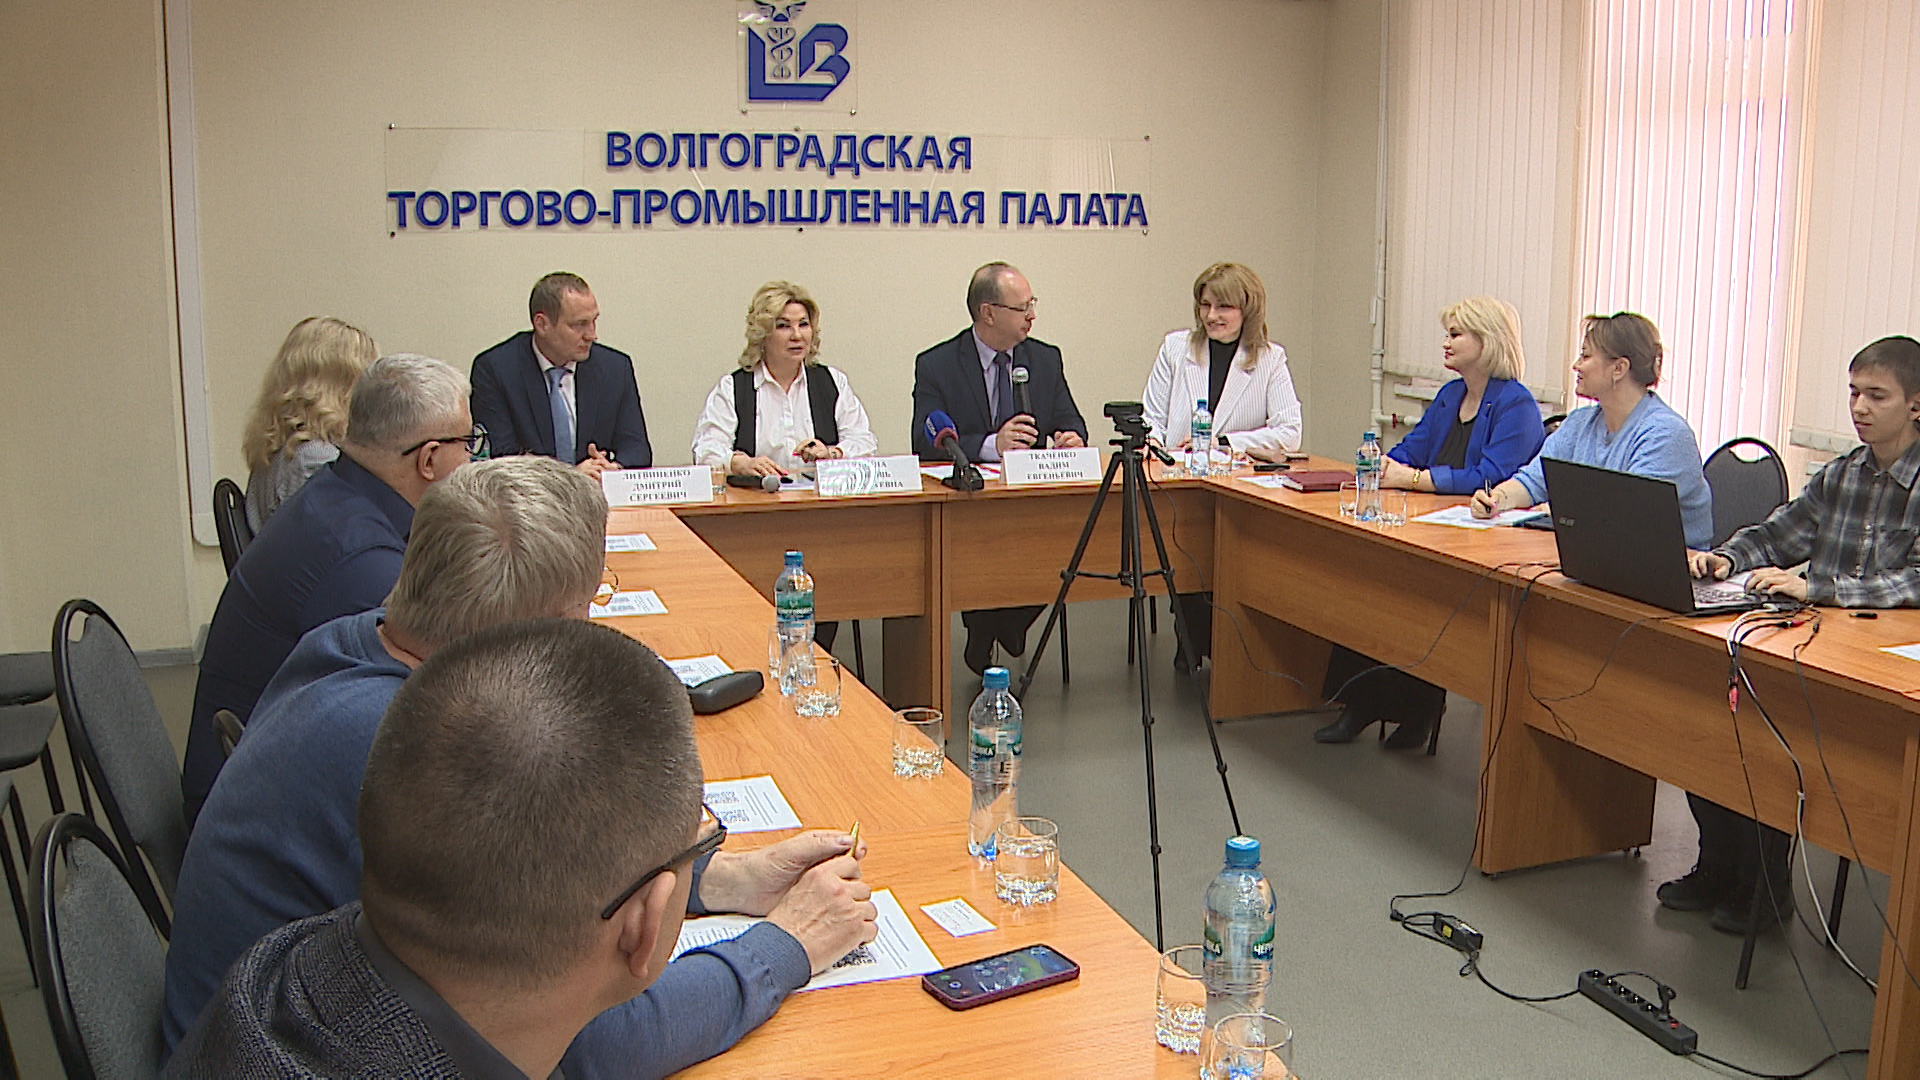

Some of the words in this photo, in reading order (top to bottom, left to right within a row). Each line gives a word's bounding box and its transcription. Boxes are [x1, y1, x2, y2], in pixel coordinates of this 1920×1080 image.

[606, 131, 973, 176] ВОЛГОГРАДСКАЯ
[388, 188, 986, 228] ТОРГОВО-ПРОМЫШЛЕННАЯ
[1000, 190, 1150, 227] ПАЛАТА
[1029, 451, 1077, 460] ТКАЧЕНКО
[1038, 461, 1070, 470] ВАДИМ
[622, 469, 691, 480] ЛИТВИНЕНКО
[1027, 471, 1083, 480] ЕВГЕНЬЕВИЧ
[633, 480, 682, 491] ДМИТРИЙ
[629, 491, 686, 501] СЕРГЕЕВИЧ
